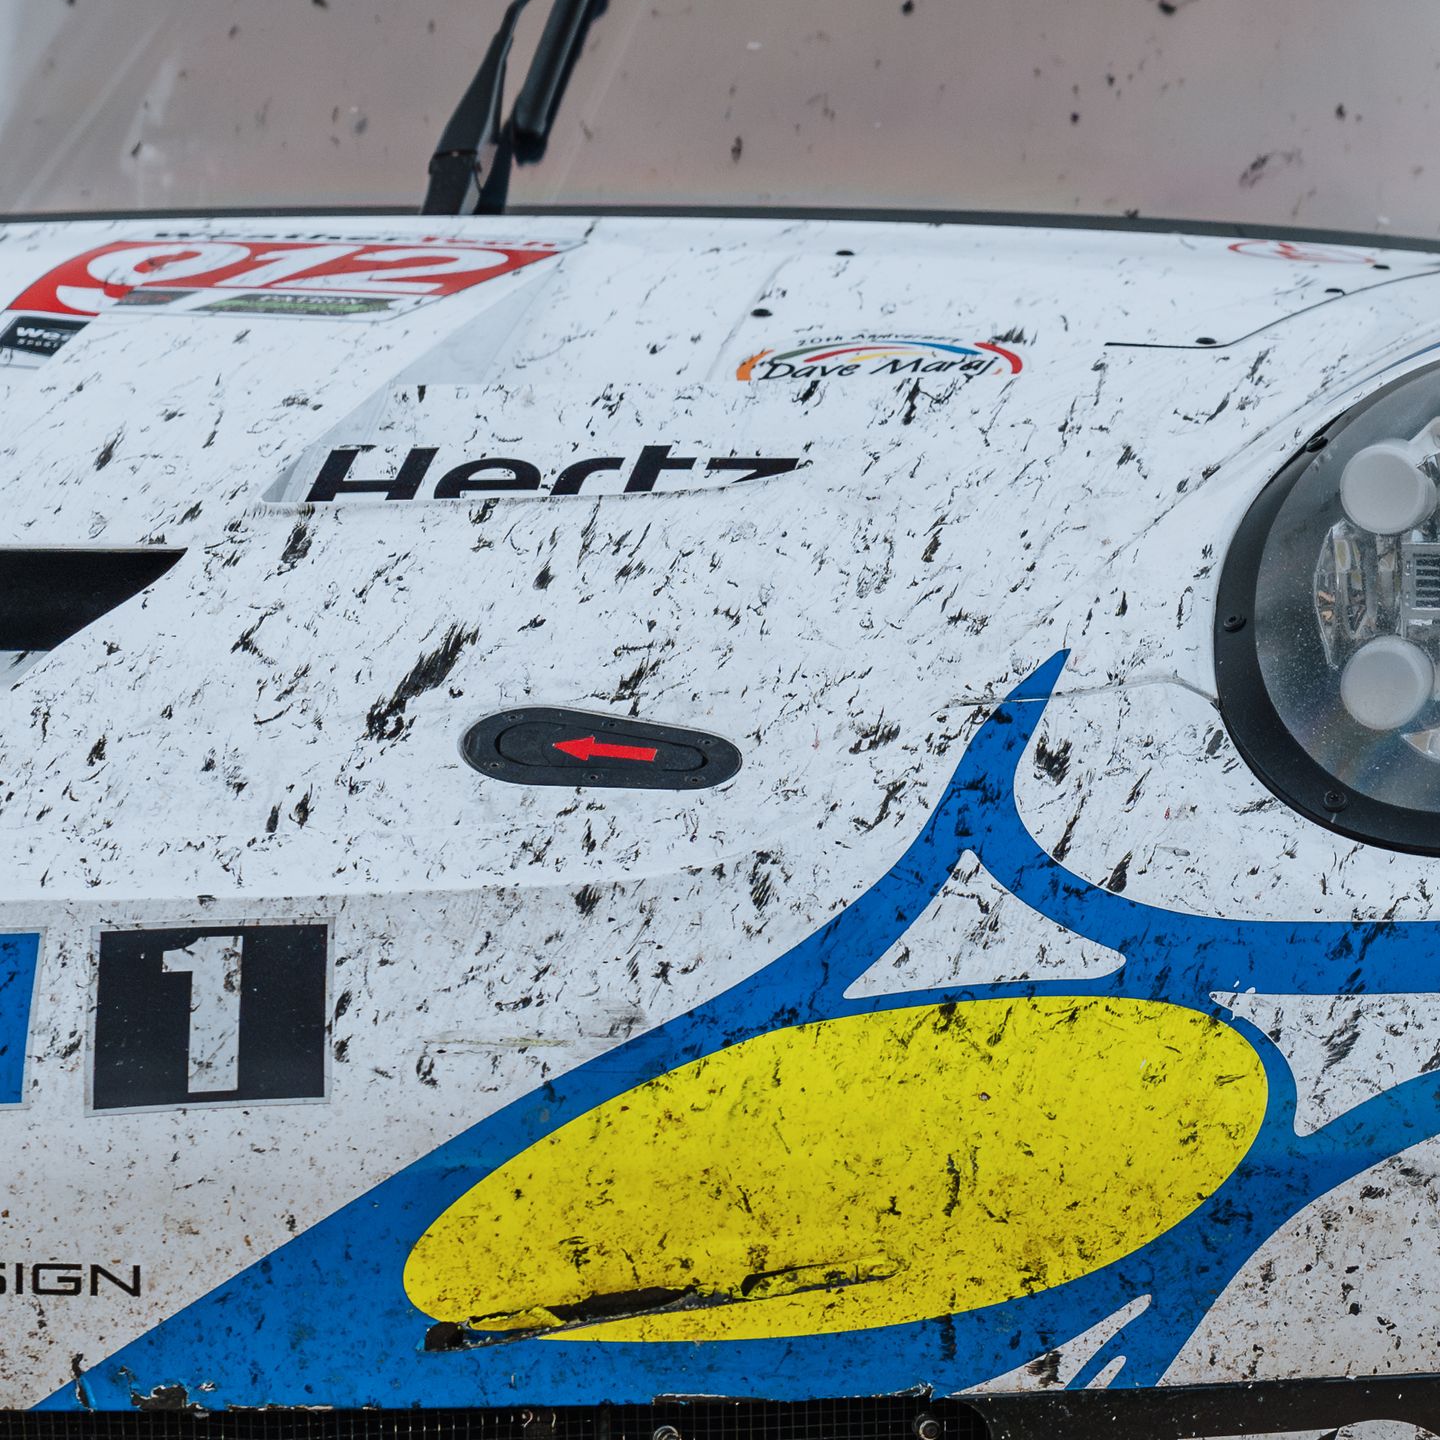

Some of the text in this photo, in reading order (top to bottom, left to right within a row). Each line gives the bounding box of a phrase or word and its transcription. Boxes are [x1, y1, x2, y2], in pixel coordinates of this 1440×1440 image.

[56, 242, 509, 314] 912
[757, 357, 999, 381] Dave Maraj
[304, 444, 801, 503] Hertz
[162, 935, 244, 1093] 1
[0, 1262, 141, 1297] IGN
